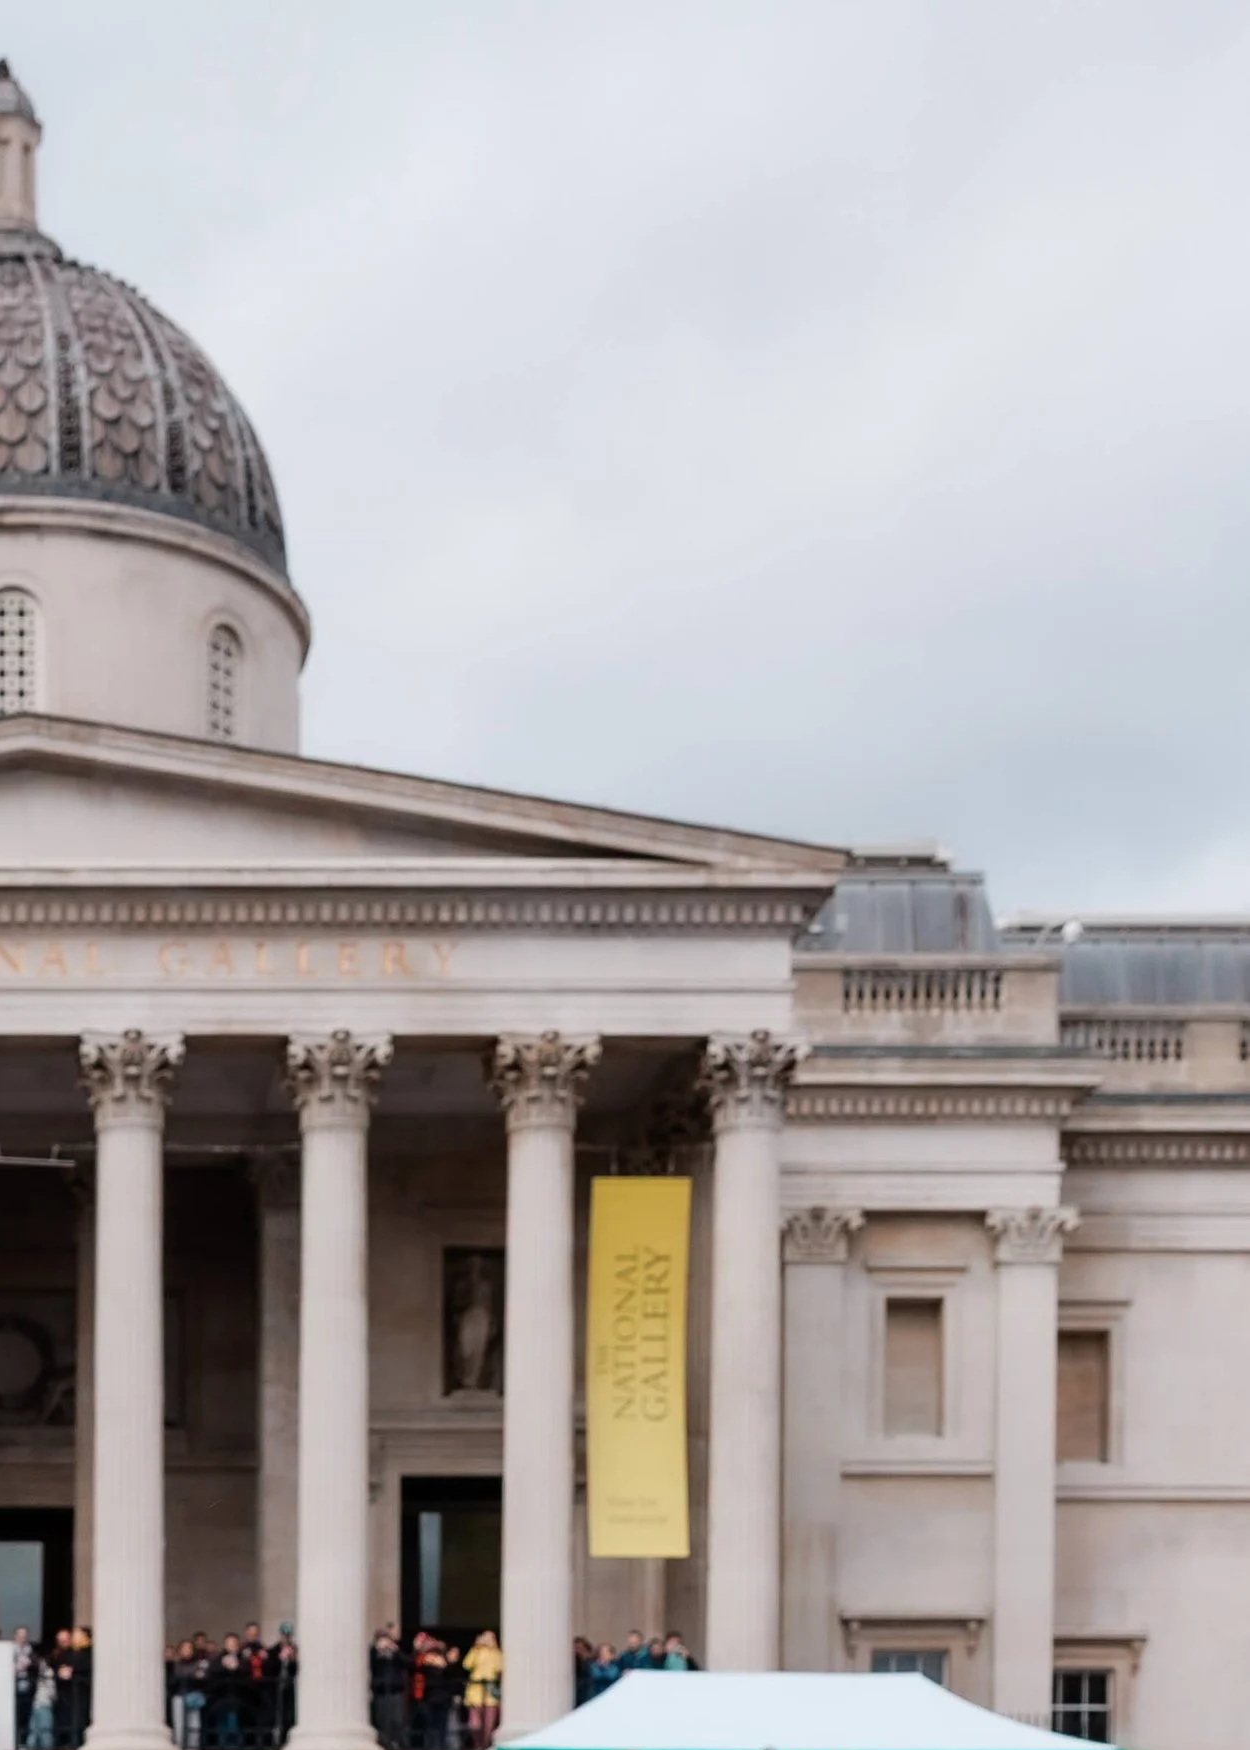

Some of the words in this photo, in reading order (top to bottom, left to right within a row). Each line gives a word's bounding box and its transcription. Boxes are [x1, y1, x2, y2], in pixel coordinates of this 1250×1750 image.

[157, 938, 460, 977] GALLERY
[610, 1242, 639, 1422] NATIONAL
[639, 1243, 671, 1425] GALLERY
